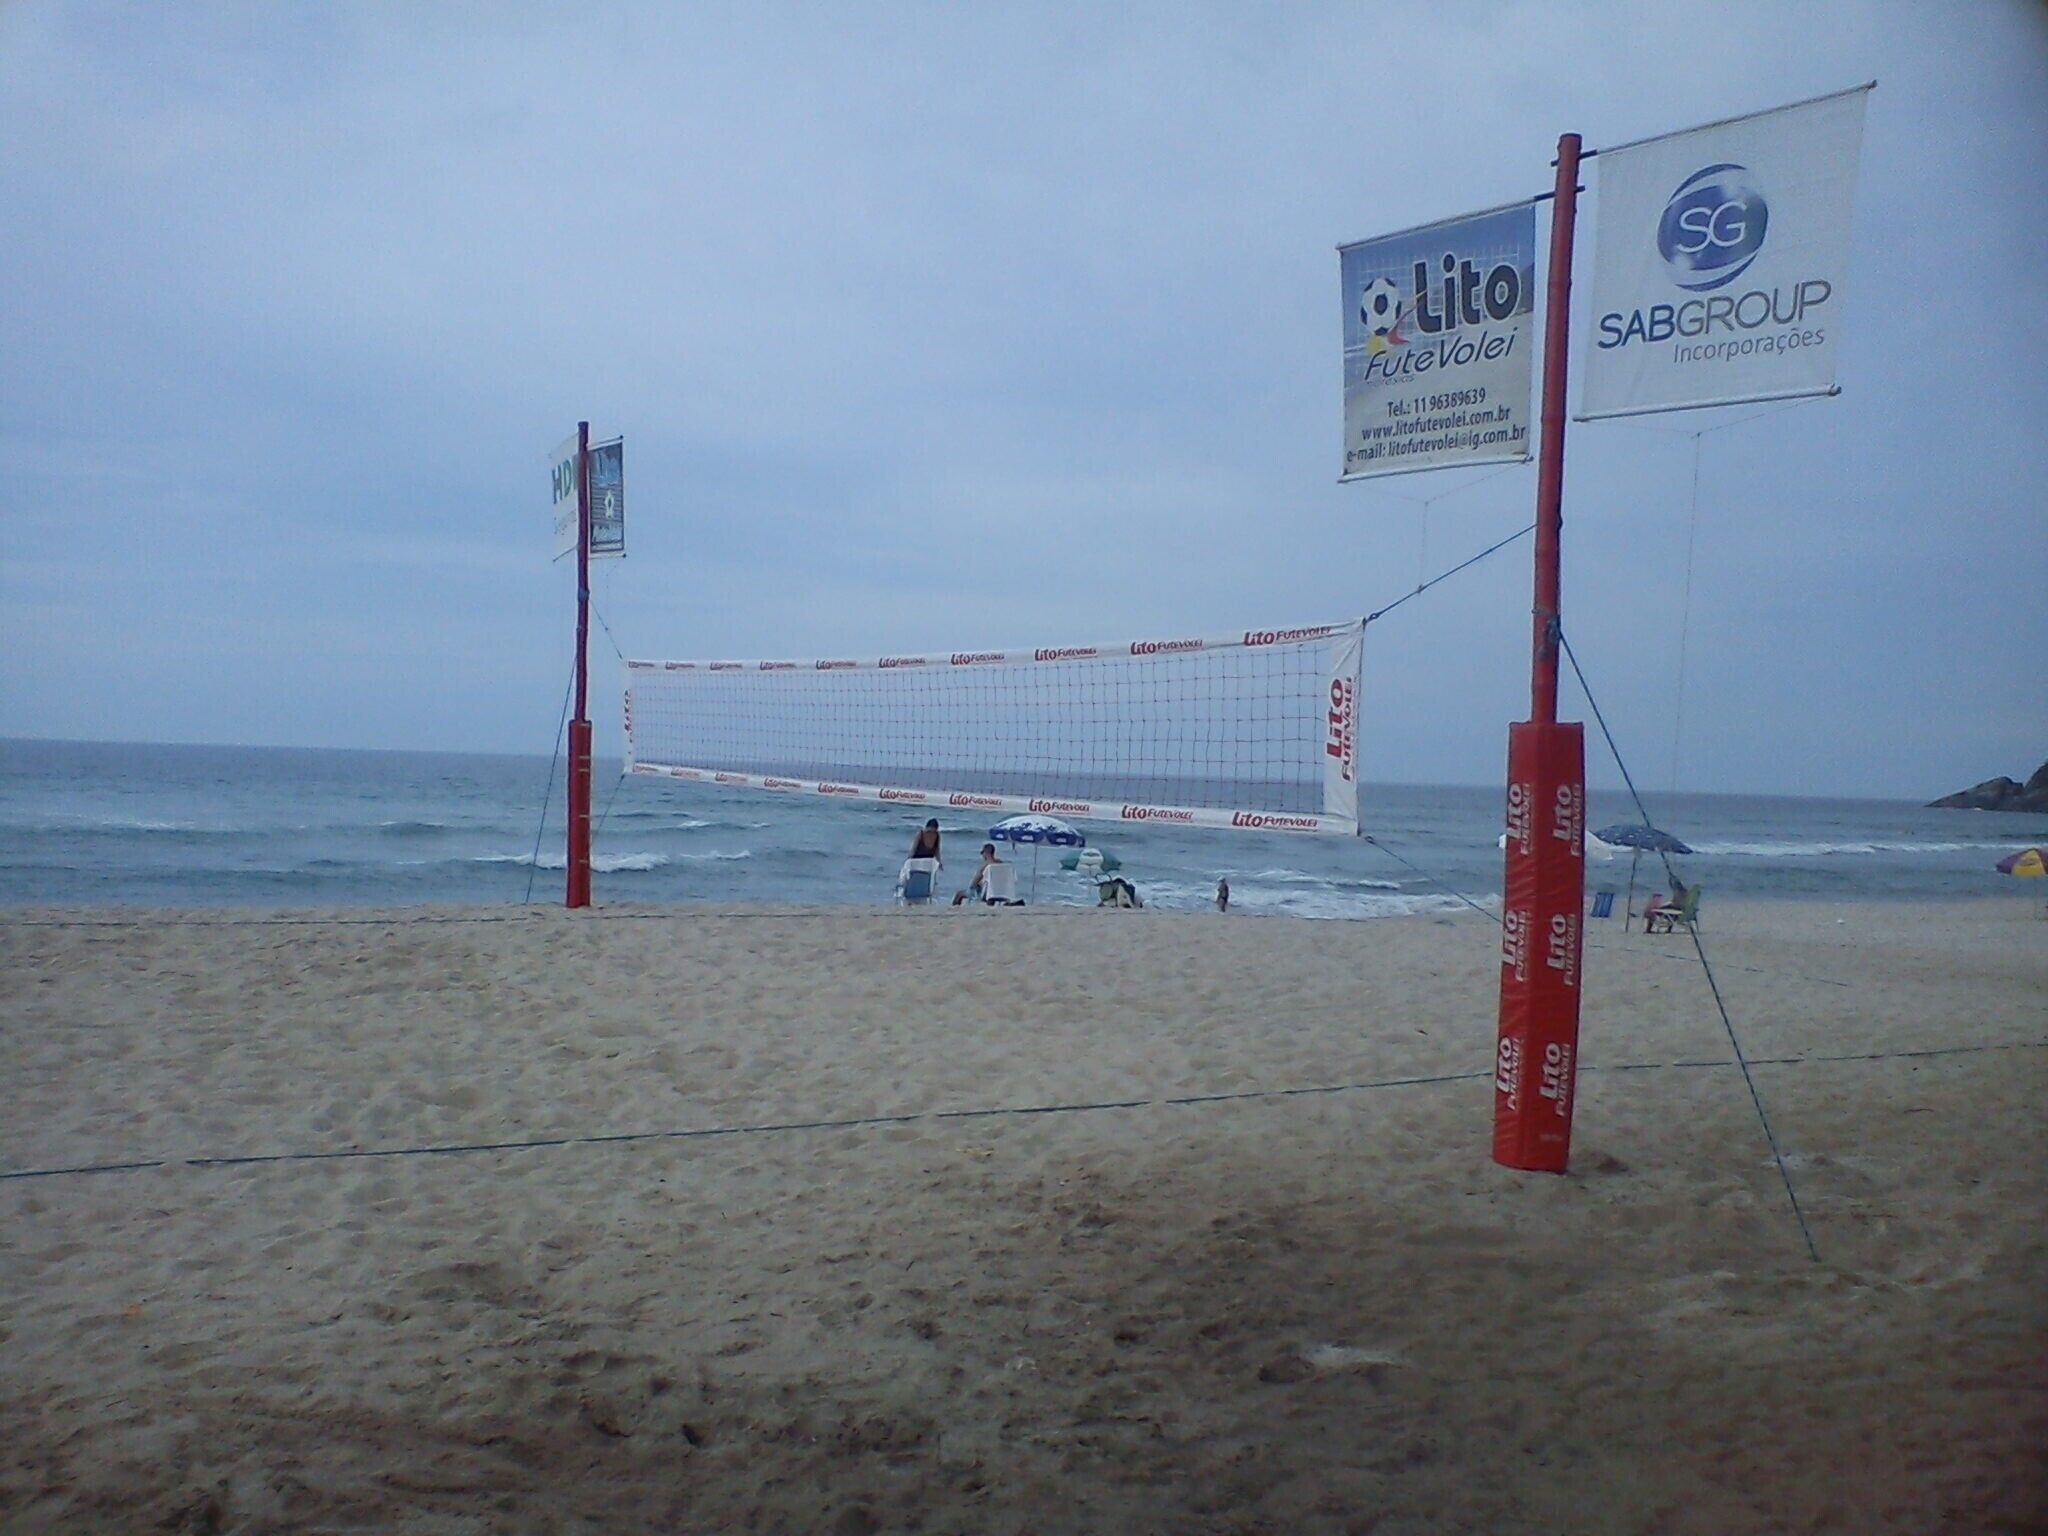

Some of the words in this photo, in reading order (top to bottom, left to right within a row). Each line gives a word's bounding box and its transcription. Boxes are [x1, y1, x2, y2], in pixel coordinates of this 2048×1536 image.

[1676, 201, 1748, 253] SG
[1413, 252, 1521, 334] Lito
[1598, 280, 1831, 349] SABGROUP
[1364, 327, 1518, 380] FuteVolei
[1673, 327, 1825, 363] Incorporações
[1387, 401, 1410, 417] Tel.:
[1362, 405, 1511, 440] www.litofutevolei.com.br
[1346, 444, 1386, 462] e-mail:
[1130, 641, 1156, 655] Lito
[1244, 631, 1274, 646] Lito
[1121, 805, 1146, 819] Lito
[1232, 811, 1263, 827] Lito
